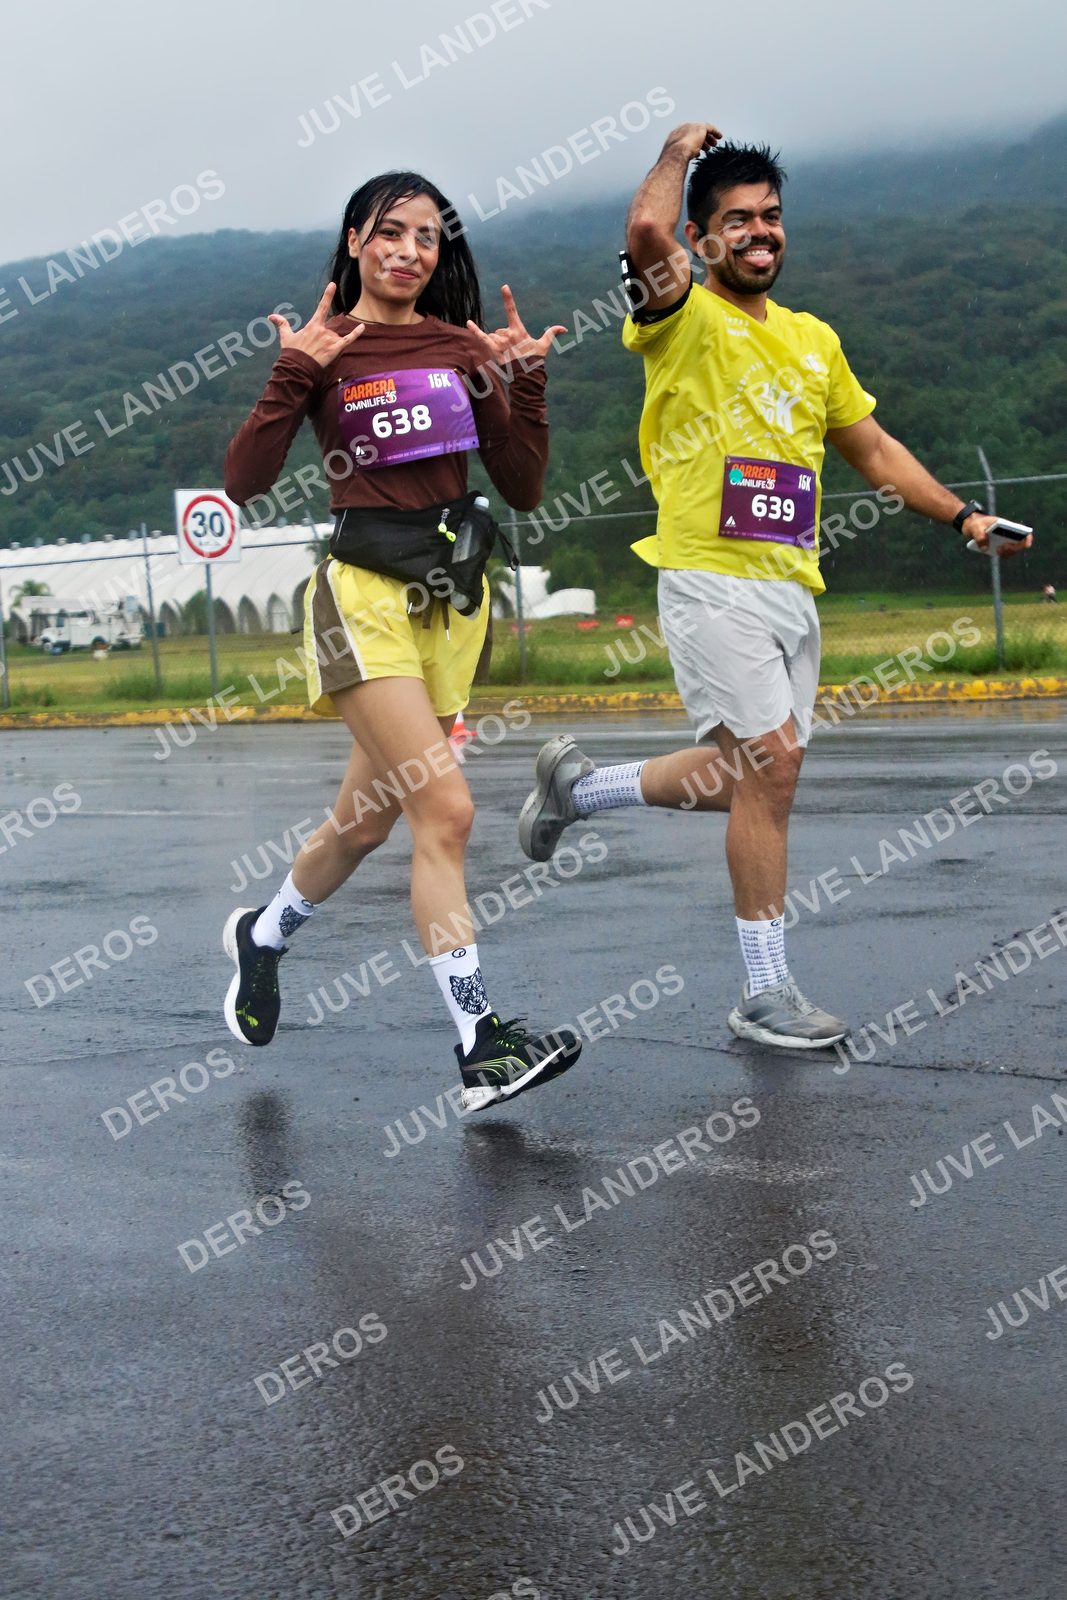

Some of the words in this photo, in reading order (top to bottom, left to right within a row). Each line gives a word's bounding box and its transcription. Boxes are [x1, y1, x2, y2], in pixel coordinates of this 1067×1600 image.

[344, 378, 396, 402] CARRERA
[344, 395, 386, 412] OMNILIFE
[372, 404, 432, 438] 638
[752, 494, 794, 522] 639
[192, 512, 224, 538] 30
